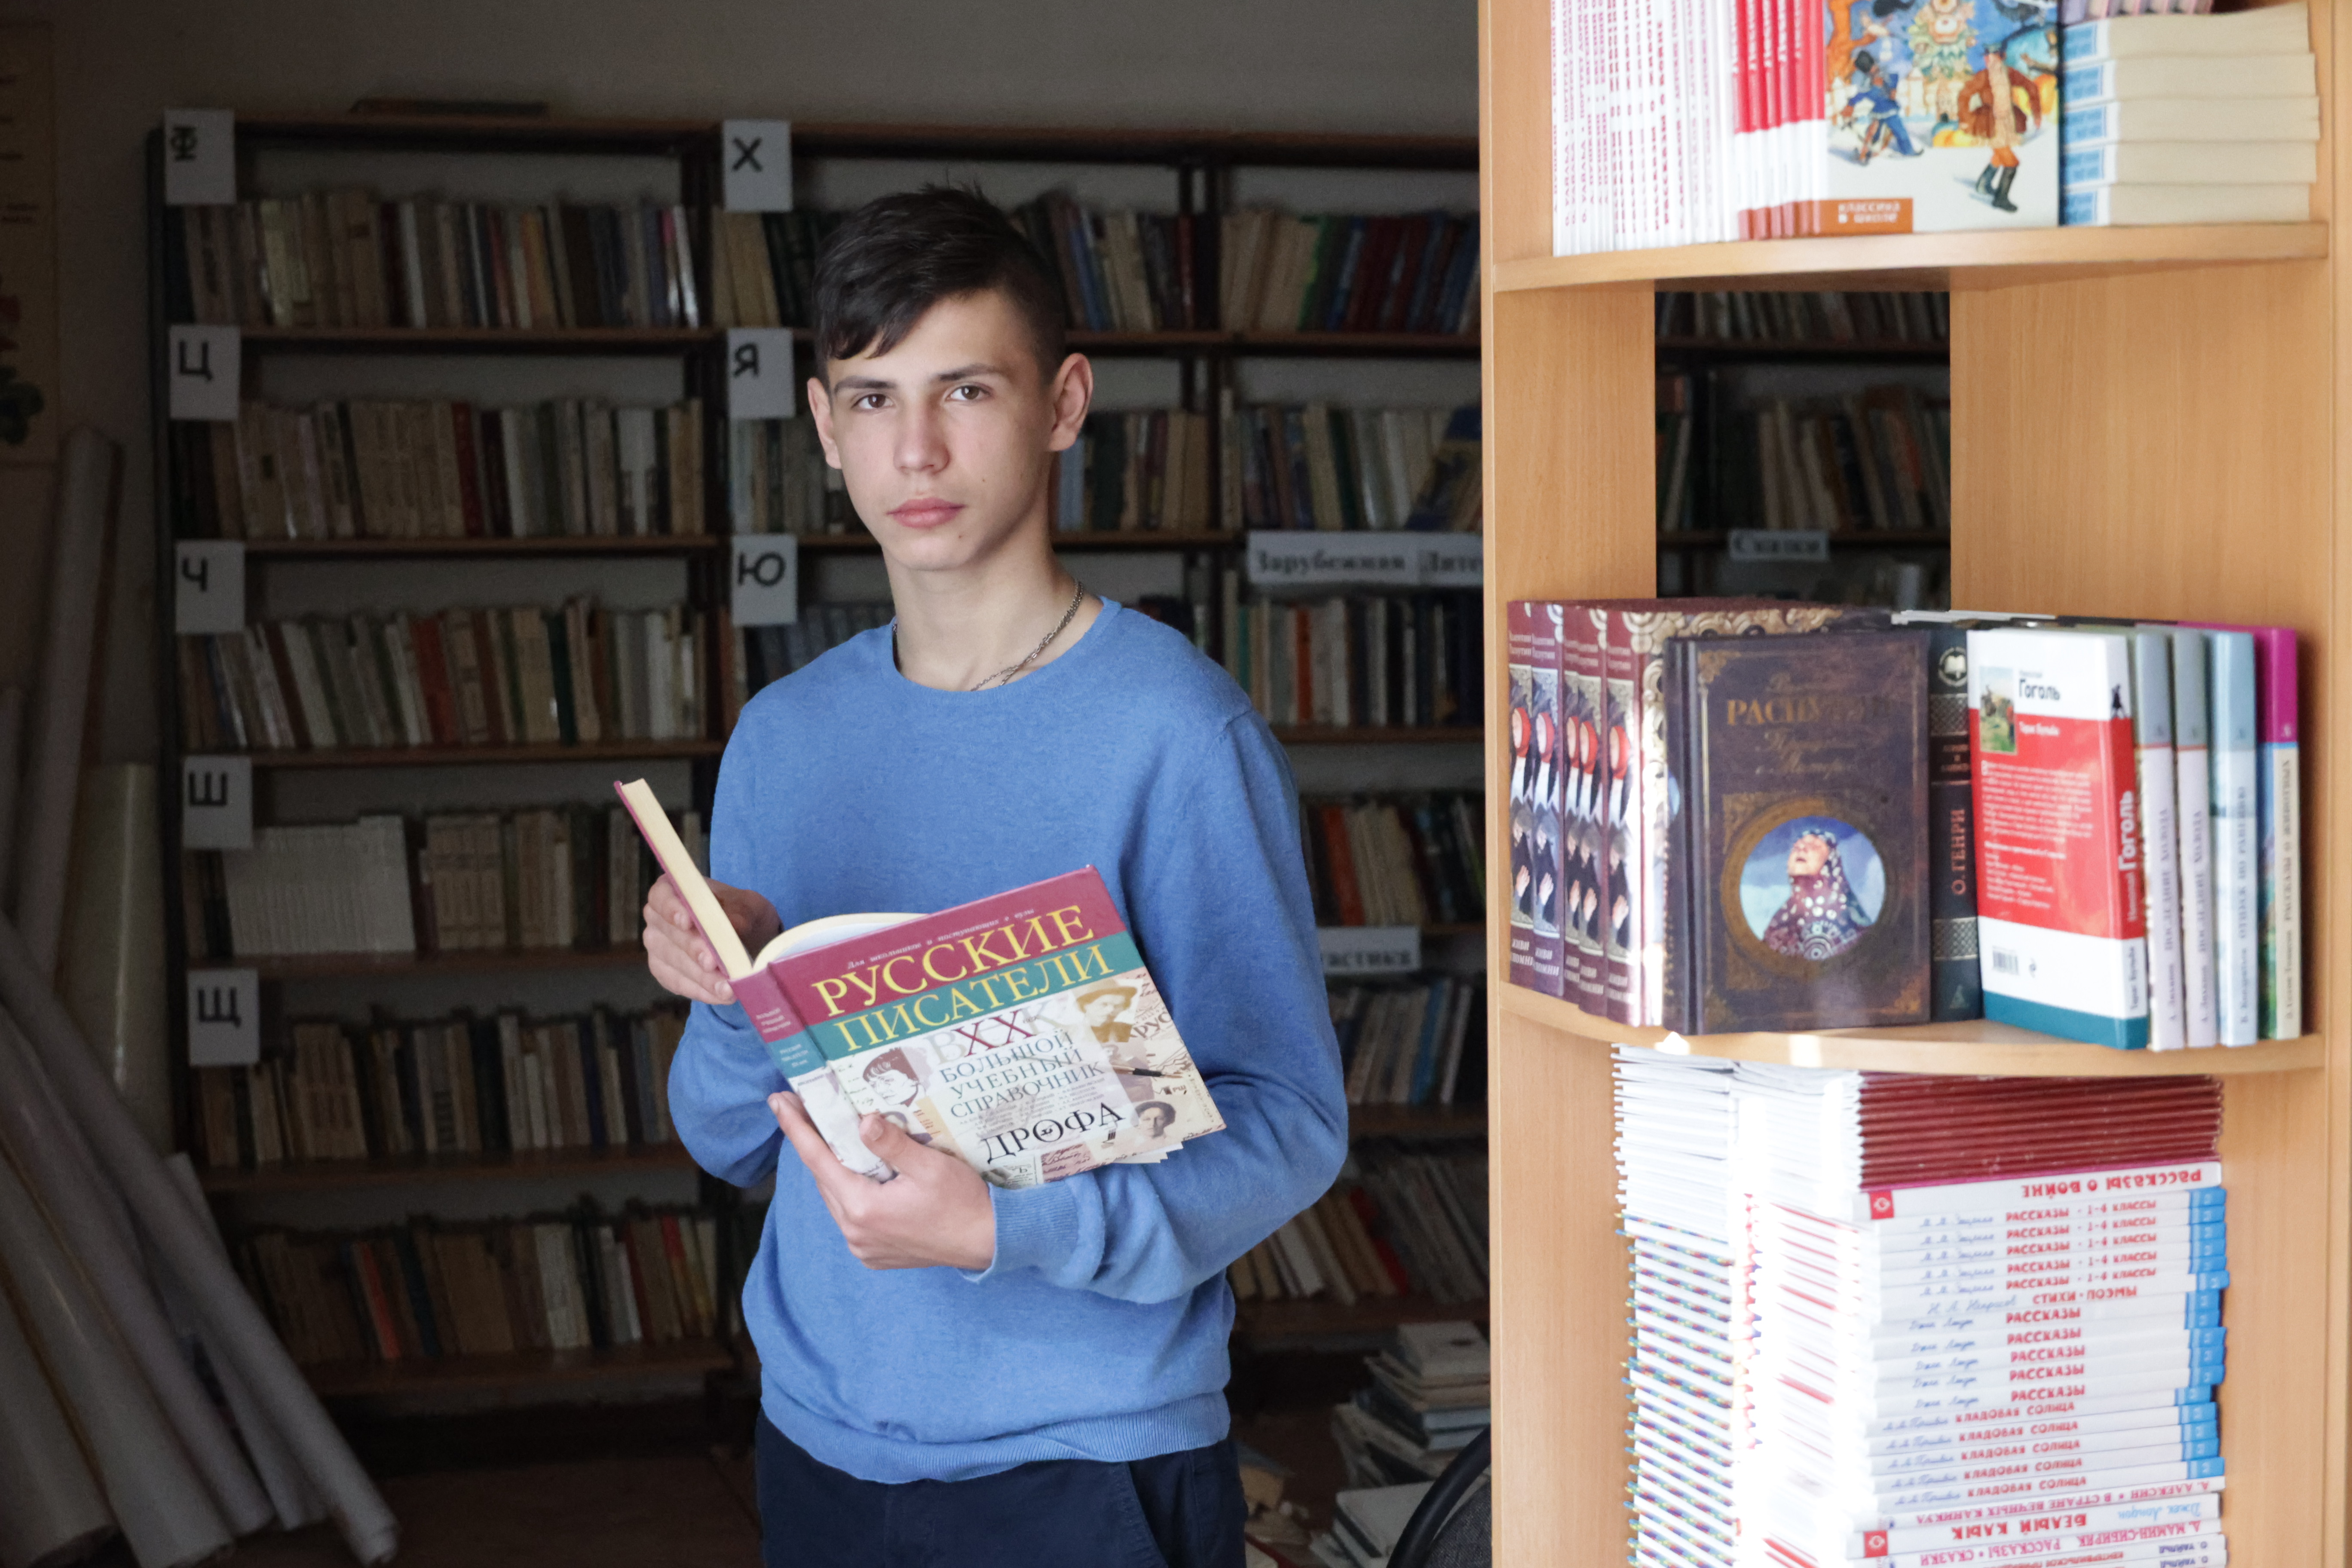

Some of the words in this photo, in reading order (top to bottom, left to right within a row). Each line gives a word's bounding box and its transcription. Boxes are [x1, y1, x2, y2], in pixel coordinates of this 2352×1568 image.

[1657, 20, 1665, 86] ВОЙНЕ
[1659, 93, 1665, 106] О
[172, 126, 197, 161] Ф
[1660, 114, 1669, 224] РАССКАЗЫ
[179, 340, 212, 382] Ц
[734, 344, 760, 378] Я
[183, 560, 208, 592] Ч
[737, 552, 786, 589] Ю
[188, 771, 227, 808] Ш
[1950, 808, 1966, 871] ГЕНРИ
[2118, 791, 2137, 871] Гоголь
[847, 958, 865, 970] Для
[937, 920, 999, 943] поступающих
[811, 904, 1094, 1017] РУССКИЕ
[197, 987, 241, 1028] Щ
[833, 944, 1115, 1052] ПИСАТЕЛИ
[939, 1029, 1075, 1084] БОЛЬШОЙ
[949, 1048, 1085, 1099] УЧЕБНЫЙ
[950, 1060, 1106, 1118] СПРАВОЧНИК
[980, 1101, 1126, 1164] ДРОФА
[2021, 1180, 2081, 1200] ВОЙНЕ
[2087, 1179, 2098, 1192] О
[2107, 1169, 2202, 1190] РАССКАЗЫ
[2005, 1208, 2069, 1222] РАССКАЗЫ
[2112, 1200, 2156, 1212] КЛАССЫ
[2006, 1225, 2070, 1239] РАССКАЗЫ
[2113, 1217, 2156, 1229] КЛАССЫ
[2006, 1240, 2070, 1256] РАССКАЗЫ
[2113, 1233, 2157, 1245] КЛАССЫ
[2007, 1259, 2070, 1274] РАССКАЗЫ
[2113, 1251, 2157, 1263] КЛАССЫ
[2006, 1276, 2070, 1289] РАССКАЗЫ
[2112, 1267, 2157, 1280] КЛАССЫ
[2032, 1291, 2076, 1305] СТИХИ
[2087, 1286, 2137, 1302] ПОЭМЫ
[2006, 1307, 2081, 1324] РАССКАЗЫ
[2007, 1327, 2082, 1345] РАССКАЗЫ
[2010, 1344, 2086, 1363] РАССКАЗЫ
[2009, 1363, 2085, 1381] РАССКАЗЫ
[2011, 1384, 2086, 1402] РАССКАЗЫ
[1955, 1407, 2020, 1423] КЛАДОВАЯ
[2026, 1401, 2075, 1416] СОЛНЦА
[1959, 1426, 2024, 1442] КЛАДОВАЯ
[2030, 1421, 2079, 1435] СОЛНЦА
[1961, 1445, 2026, 1461] КЛАДОВАЯ
[2032, 1439, 2081, 1453] СОЛНЦА
[1964, 1464, 2028, 1479] КЛАДОВАЯ
[2035, 1458, 2083, 1472] СОЛНЦА
[1967, 1482, 2032, 1498] КЛАДОВАЯ
[2039, 1476, 2087, 1491] СОЛНЦА
[2104, 1492, 2111, 1502] В
[2131, 1482, 2193, 1499] АЛЕКСИН
[1988, 1500, 2045, 1517] ВЕЧНЫХ
[2048, 1494, 2100, 1509] СТРАНЕ
[2118, 1504, 2164, 1521] Лондон
[2166, 1502, 2202, 1518] Джек
[1917, 1507, 1983, 1524] КАНИКУЛ
[2020, 1513, 2087, 1535] БЕЛЫЙ
[1952, 1522, 2008, 1540] КЛЫК
[2077, 1522, 2186, 1547] МАМИН-СИБИРЯК
[1920, 1549, 1974, 1566] СКАЗКИ
[1988, 1537, 2061, 1559] РАССКАЗЫ
